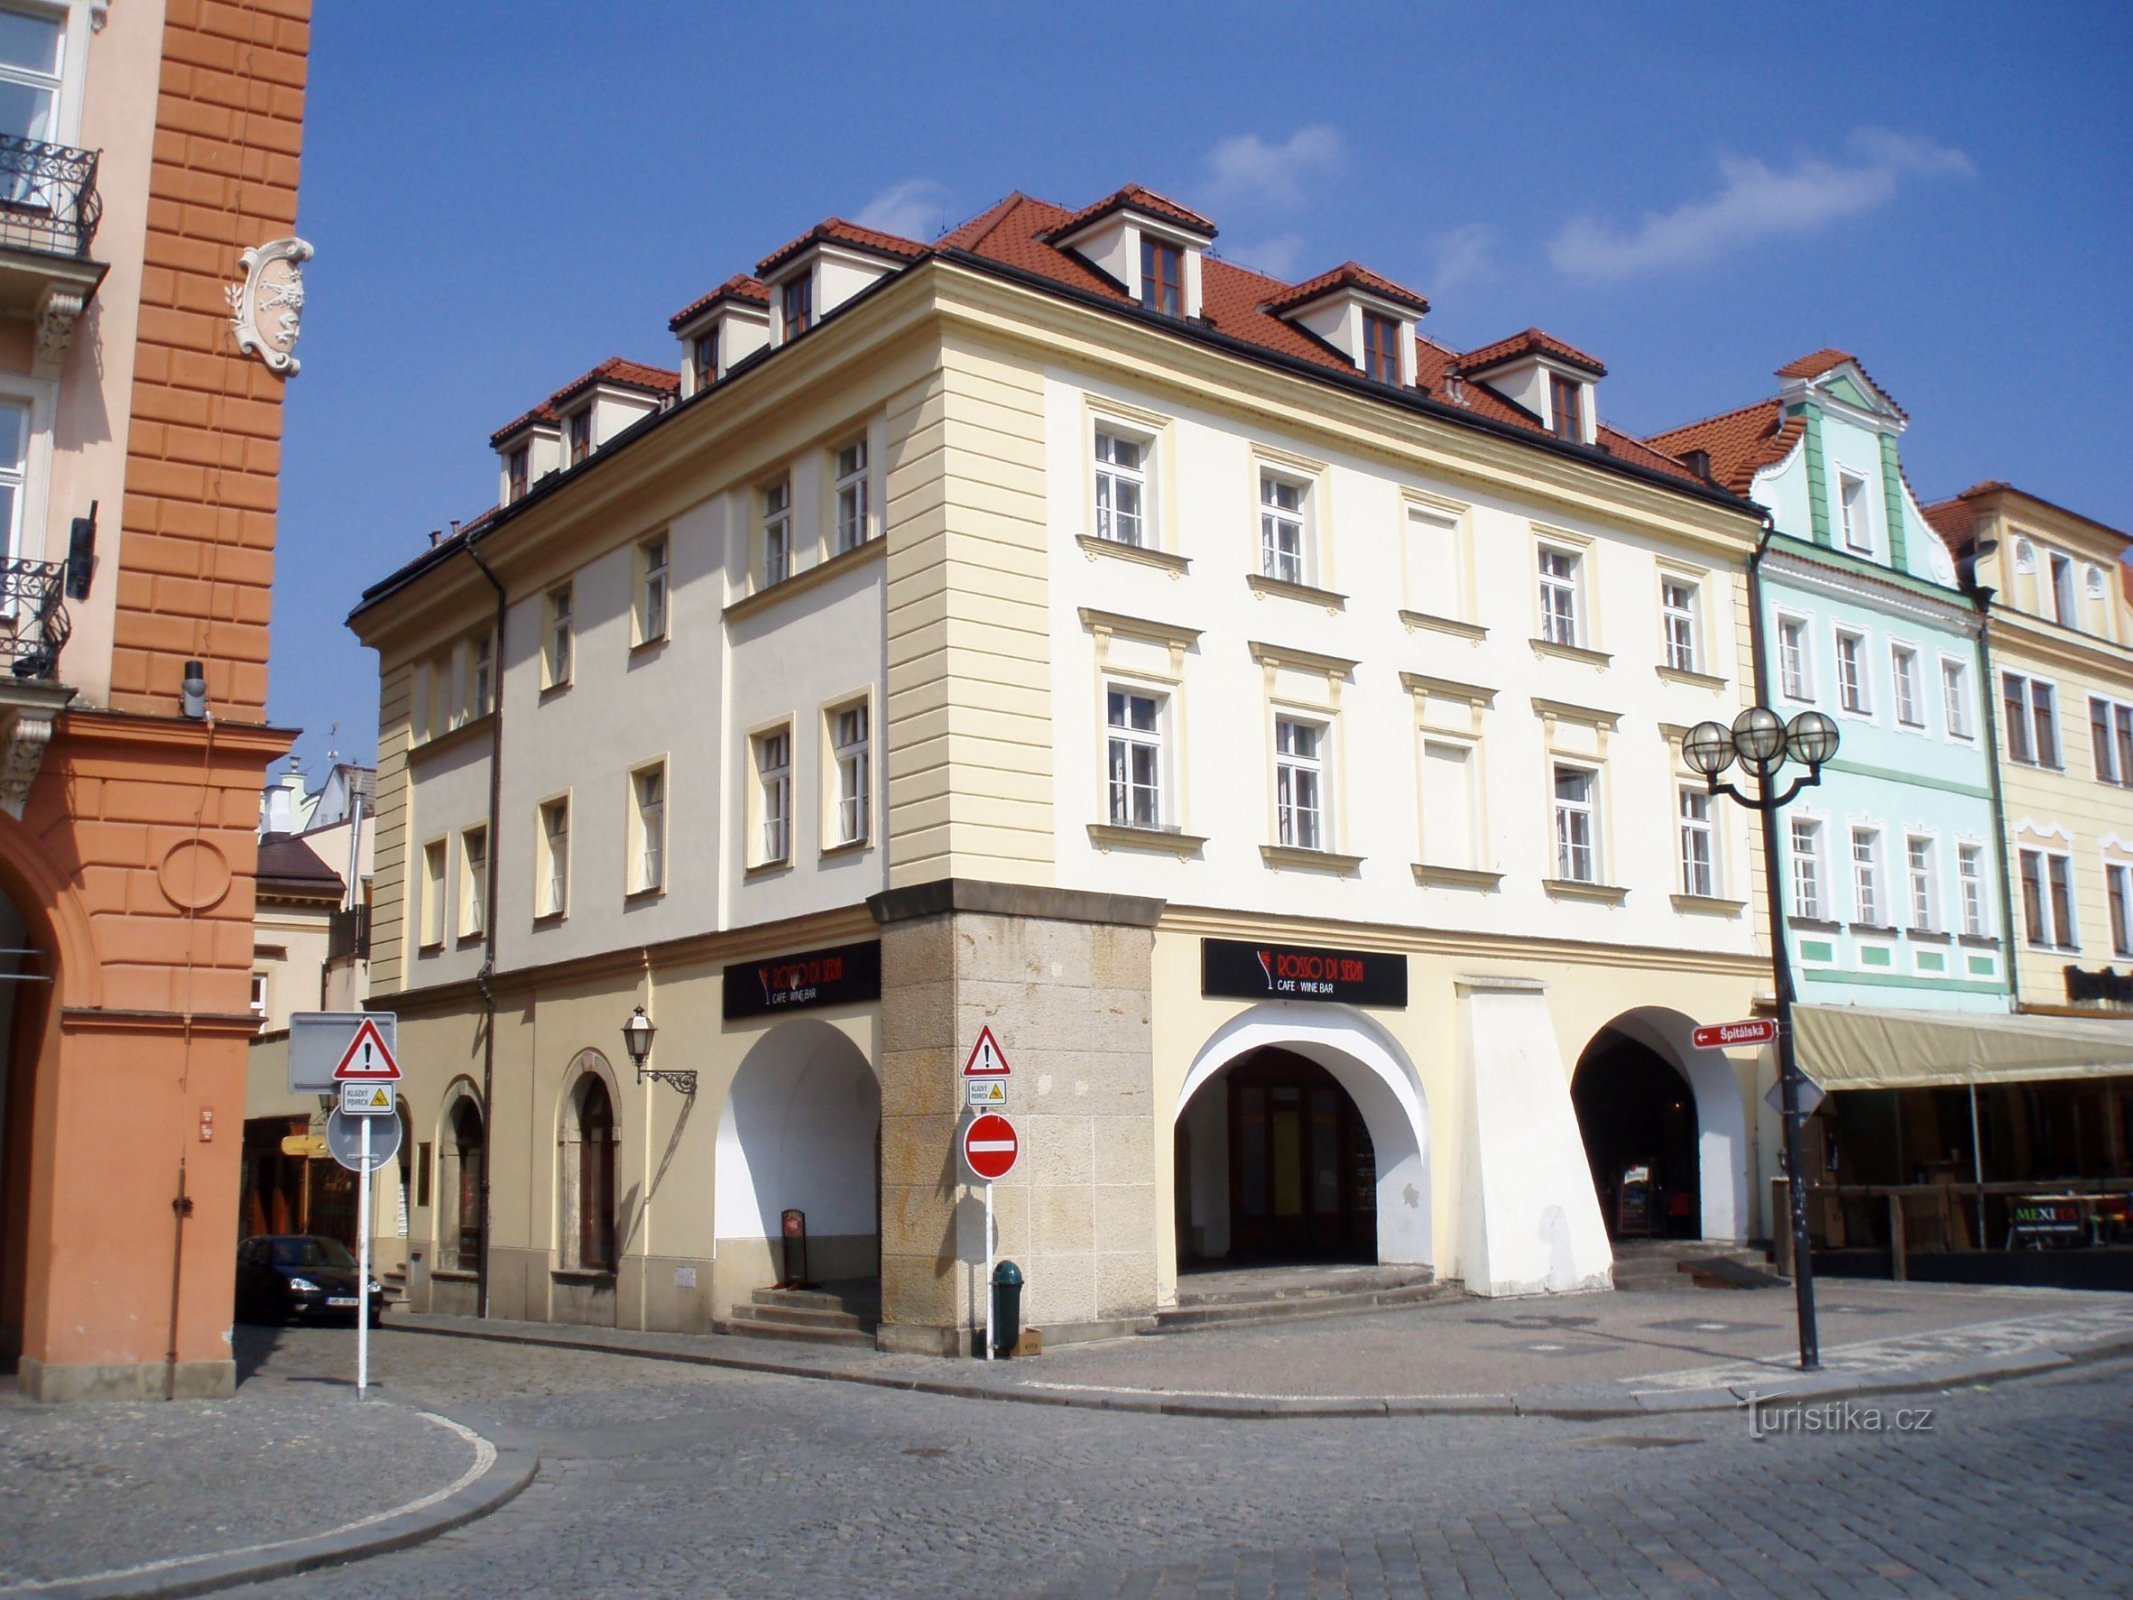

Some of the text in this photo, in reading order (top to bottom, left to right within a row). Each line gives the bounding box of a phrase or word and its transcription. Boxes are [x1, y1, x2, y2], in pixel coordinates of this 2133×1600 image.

[1277, 954, 1364, 982] ROSSO DI SERA
[1277, 980, 1334, 993] CAFE WINE BAR
[772, 991, 787, 1004] CAFE
[804, 988, 817, 1000] BAR
[1720, 1024, 1764, 1042] Špitálská
